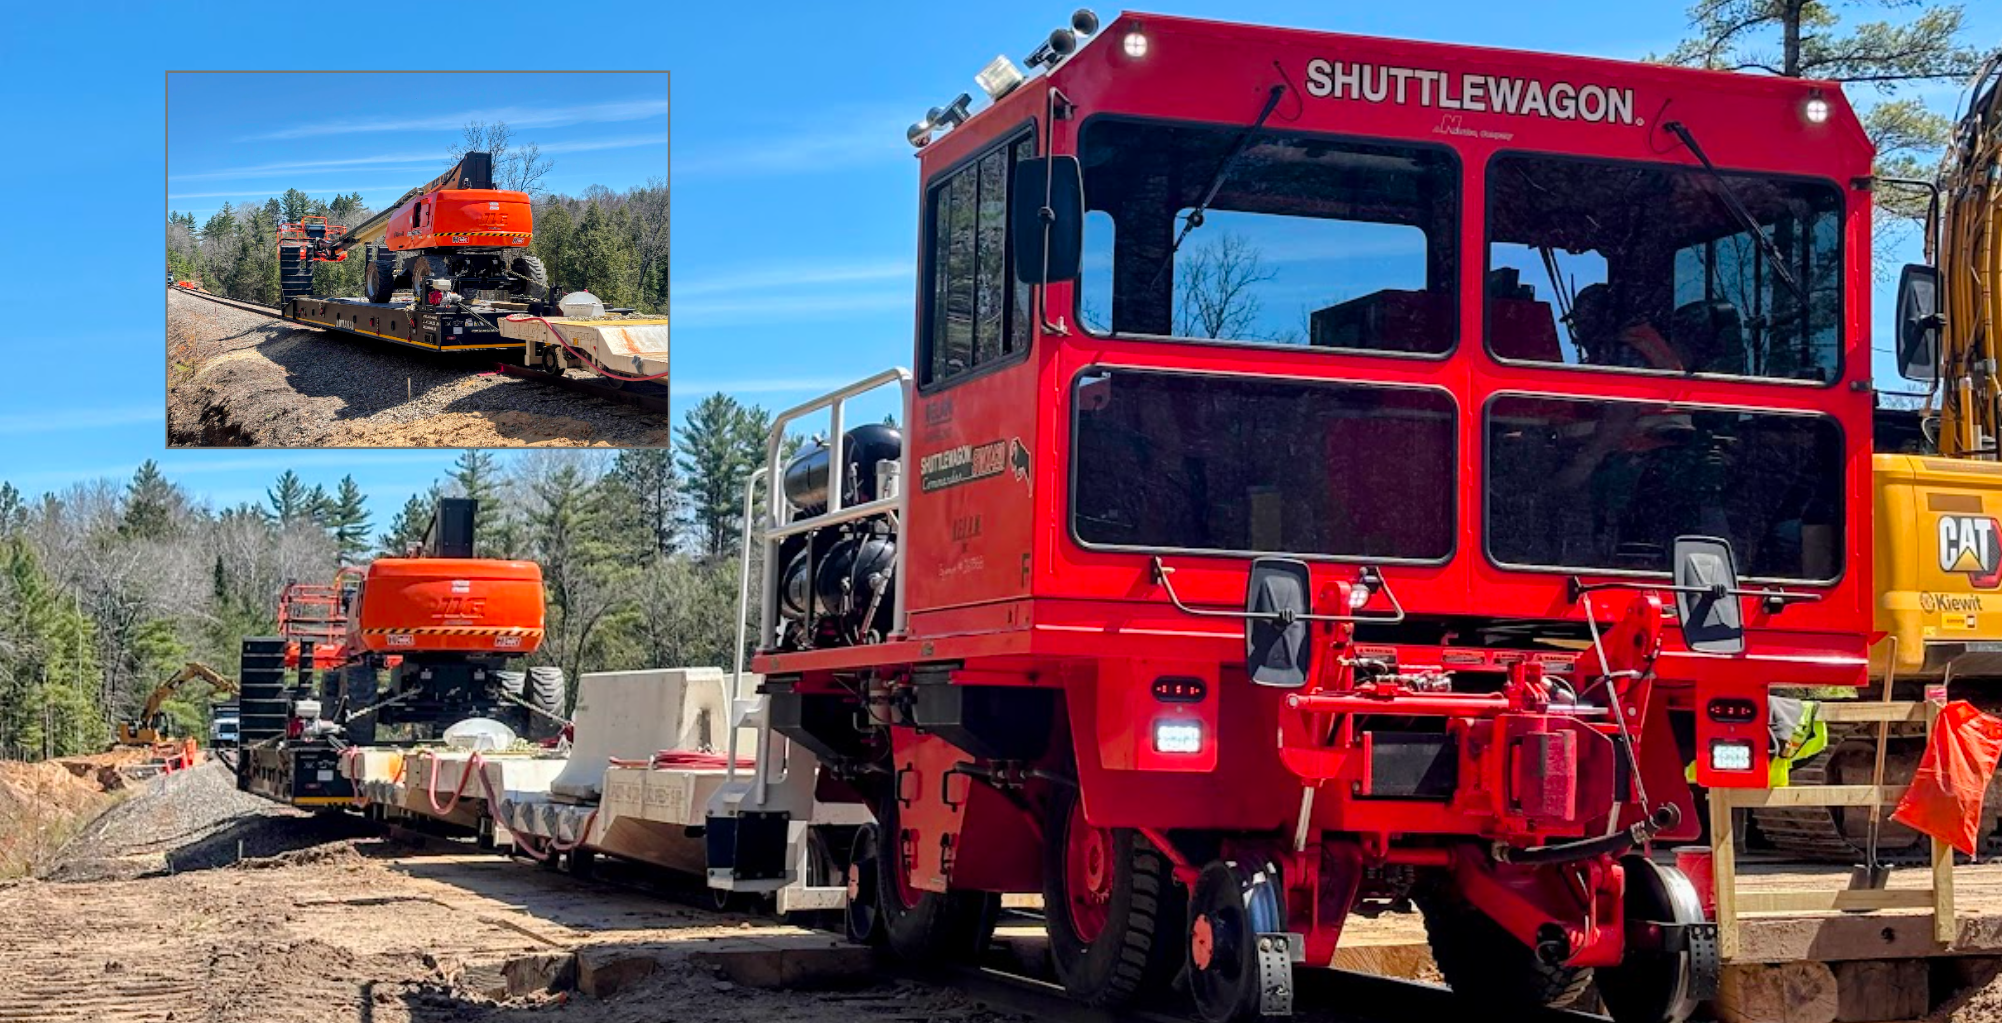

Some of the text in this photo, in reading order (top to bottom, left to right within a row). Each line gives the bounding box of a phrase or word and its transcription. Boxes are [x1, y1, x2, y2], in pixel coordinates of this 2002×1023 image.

[1305, 57, 1635, 126] SHUTTLEWAGON
[1939, 516, 1992, 571] CAT
[1021, 552, 1031, 588] F
[1935, 593, 1983, 611] Kiewit
